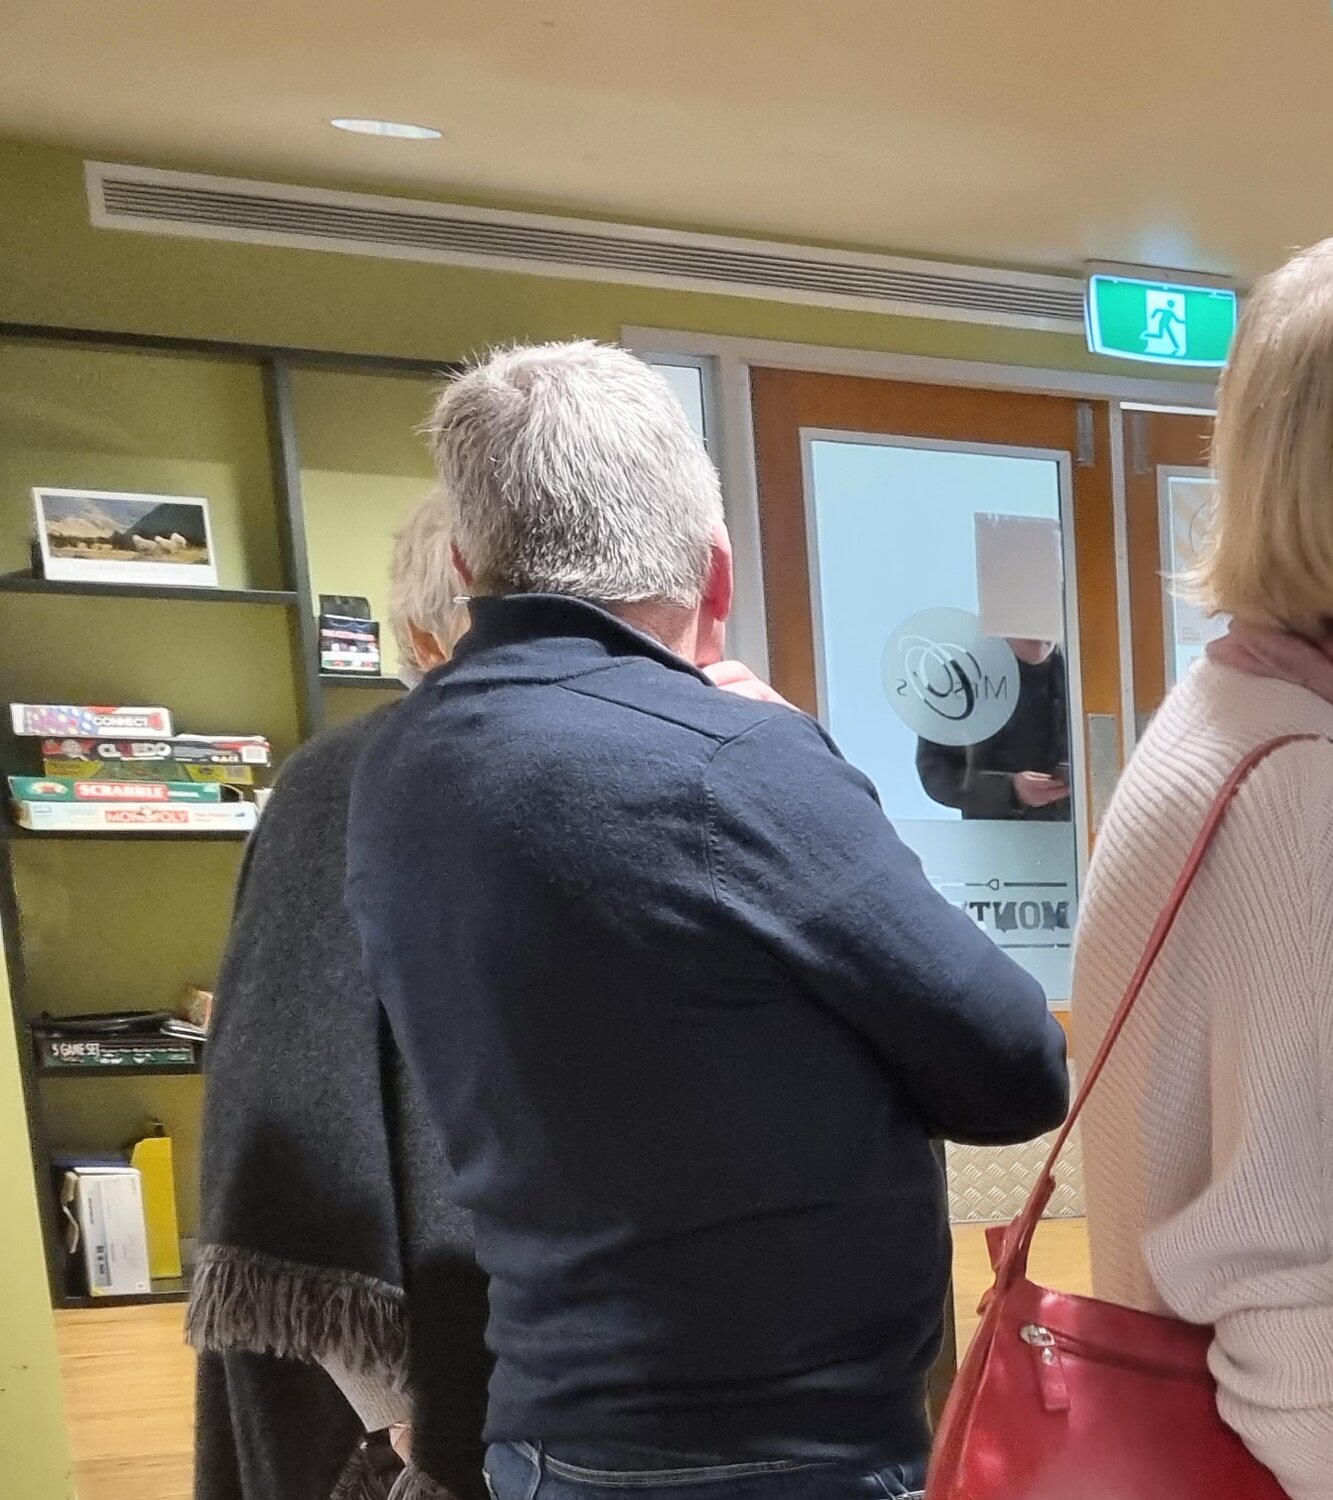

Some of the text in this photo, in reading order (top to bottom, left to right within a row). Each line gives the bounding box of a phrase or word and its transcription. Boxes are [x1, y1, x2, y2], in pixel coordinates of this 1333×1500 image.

[93, 714, 149, 728] CONNECT
[77, 783, 164, 799] SCRABBLE
[105, 810, 189, 823] MONOPOLY
